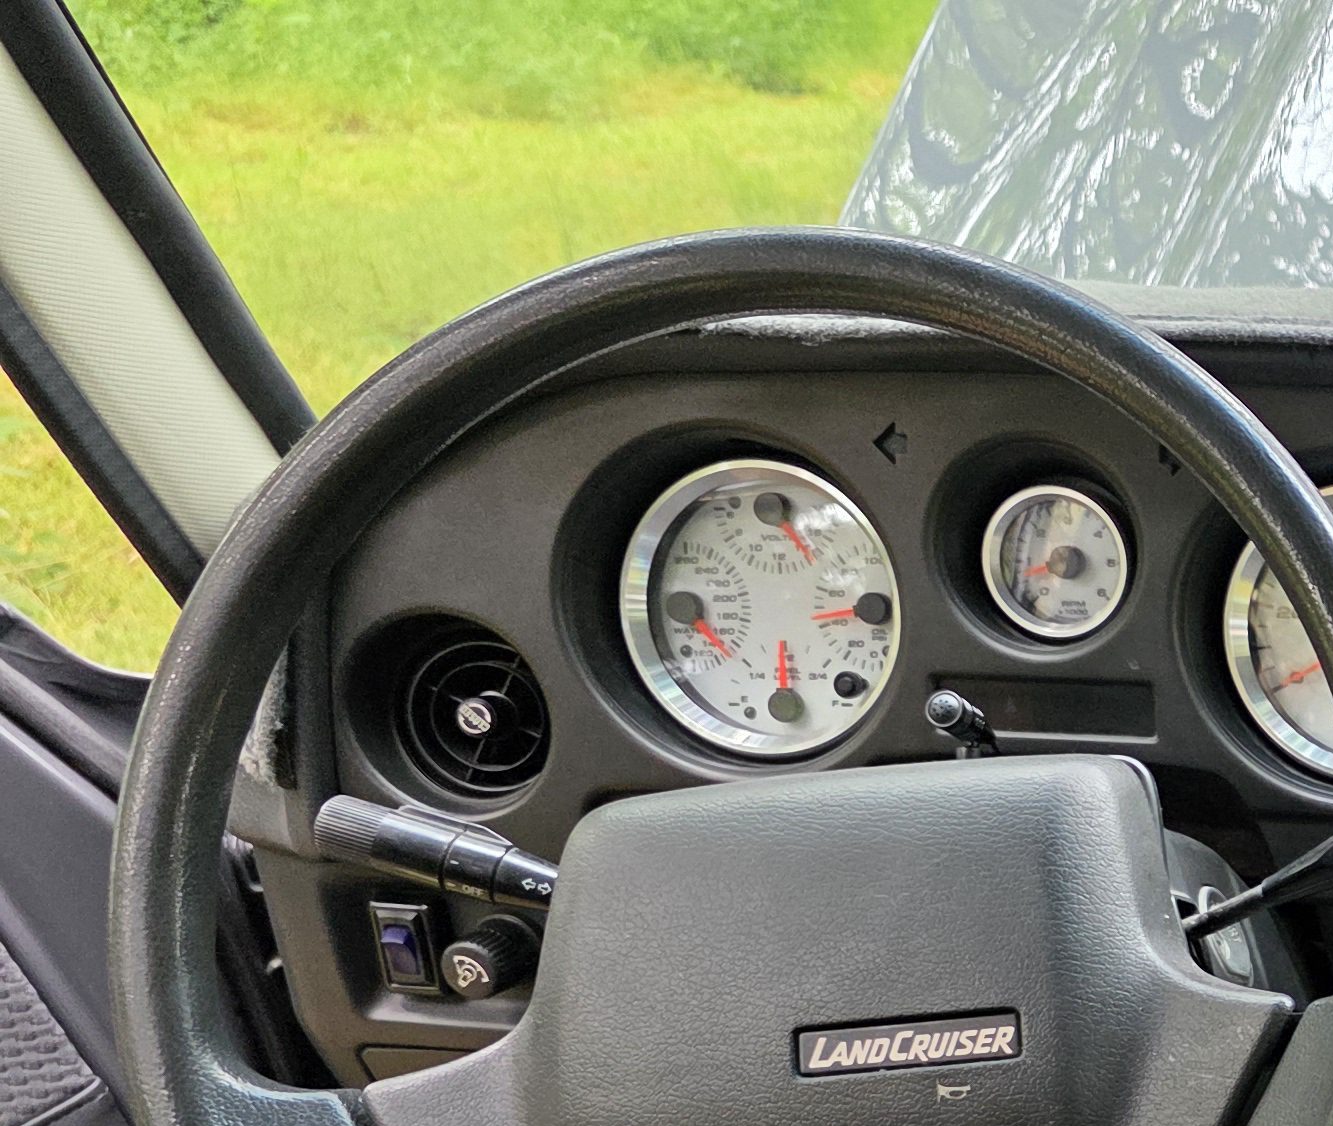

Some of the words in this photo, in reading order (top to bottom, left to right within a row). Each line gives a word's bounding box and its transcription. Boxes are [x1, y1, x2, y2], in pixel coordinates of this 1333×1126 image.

[1093, 530, 1104, 539] 4
[748, 544, 763, 552] 10
[772, 553, 787, 561] 12
[828, 589, 846, 598] 60
[1039, 587, 1050, 597] 0
[1096, 588, 1107, 598] 6
[712, 594, 738, 603] 200
[1061, 600, 1087, 608] RPM
[716, 612, 739, 620] 180
[713, 627, 736, 636] 160
[848, 640, 865, 648] 20
[870, 650, 879, 659] 0
[749, 672, 766, 680] 1/4
[740, 695, 749, 704] E
